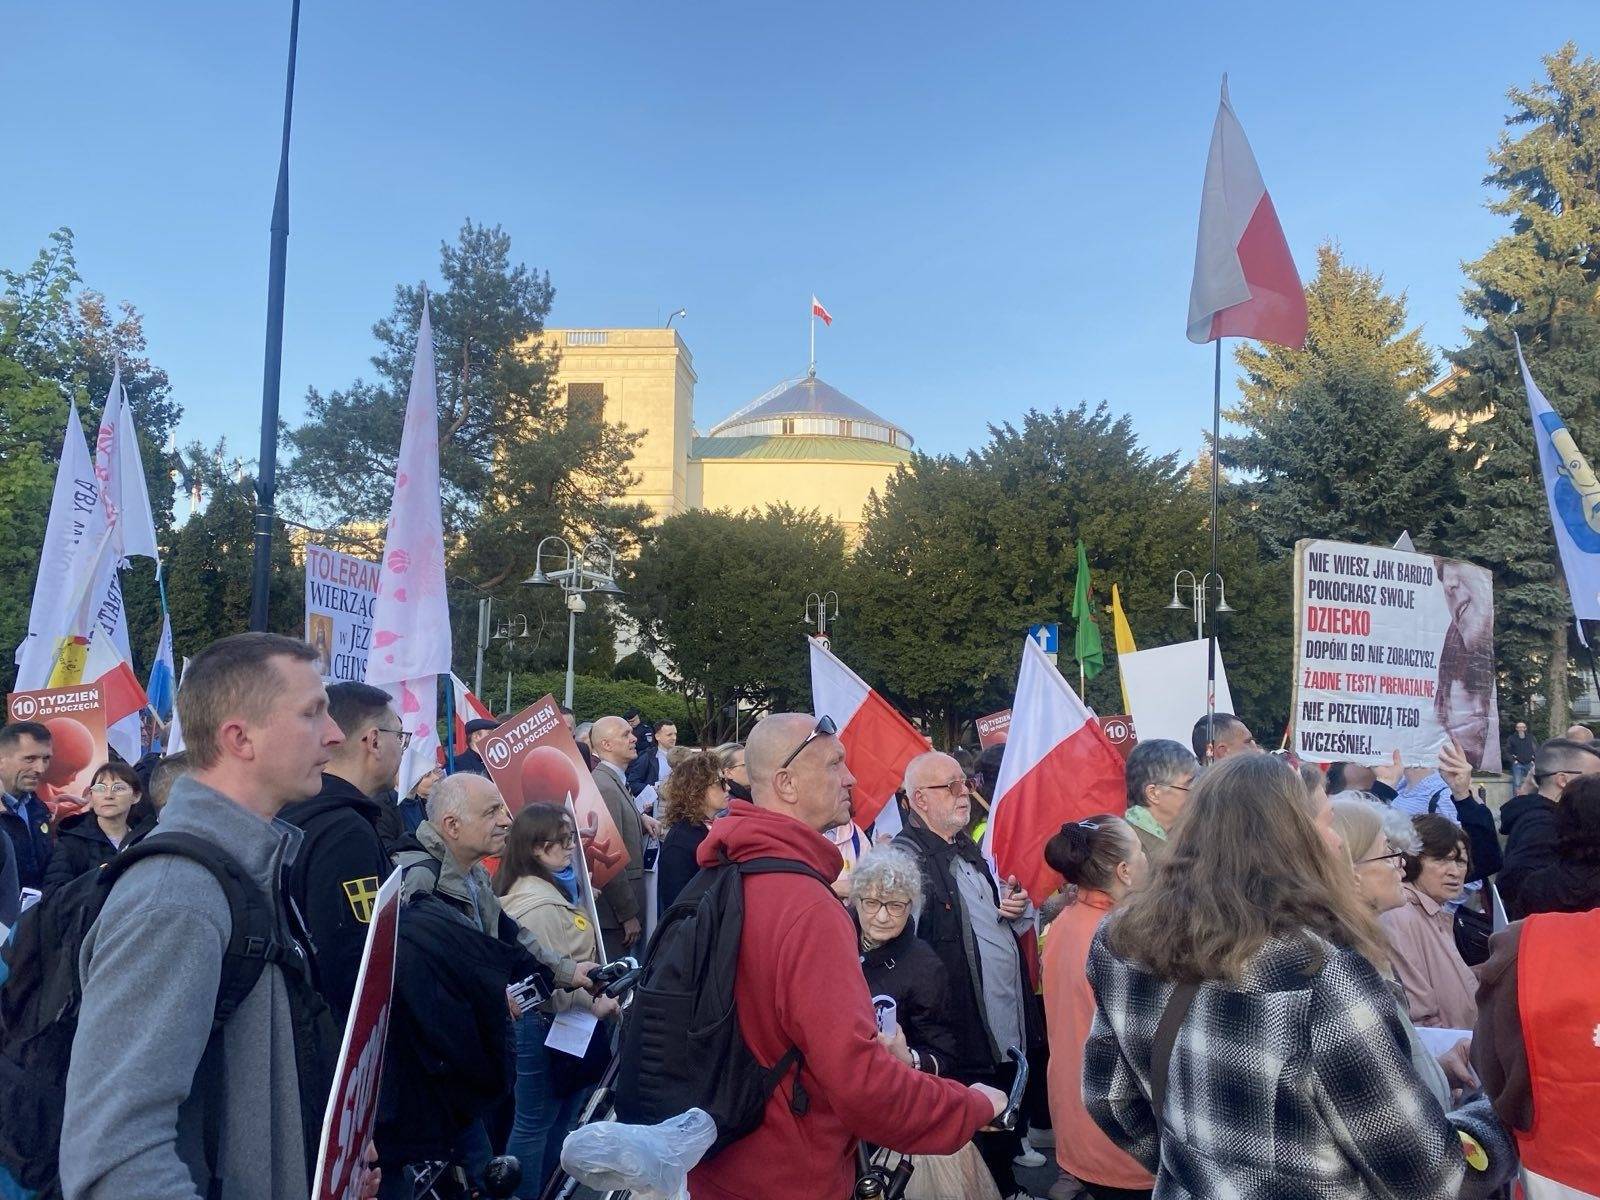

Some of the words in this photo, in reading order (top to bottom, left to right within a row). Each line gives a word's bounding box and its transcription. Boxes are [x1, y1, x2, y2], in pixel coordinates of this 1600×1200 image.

[310, 549, 381, 594] TOLERAN
[1309, 552, 1330, 573] NIE
[1333, 554, 1370, 578] WIESZ
[1373, 560, 1395, 580] JAK
[1397, 562, 1433, 586] BARDZO
[310, 580, 377, 624] WIERZĄC
[1308, 579, 1377, 605] POKOCHASZ
[1380, 586, 1415, 610] SWOJE
[1307, 606, 1371, 637] DZIECKO
[348, 624, 371, 653] JEZ
[1305, 639, 1347, 660] DOPÓKI
[1351, 643, 1365, 662] GO
[1368, 645, 1384, 664] NIE
[1387, 646, 1437, 669] ZOBACZYSZ.
[38, 689, 99, 706] TYDZIEŃ
[1304, 667, 1342, 691] ŻADNE
[1346, 673, 1377, 693] TESTY
[1379, 675, 1435, 698] PRENATALNE
[14, 701, 35, 715] 10
[40, 707, 52, 715] OD
[54, 702, 100, 713] POCZĘCIA
[505, 704, 555, 743] TYDZIEŃ
[1302, 701, 1325, 722] NIE
[1328, 702, 1393, 729] PRZEWIDZĄ
[1396, 707, 1420, 728] TEGO
[488, 742, 508, 764] 10
[512, 742, 524, 754] OD
[524, 718, 560, 747] POCZĘCIA
[1106, 725, 1126, 739] 10
[1301, 730, 1381, 756] WCZEŚNIEJ...
